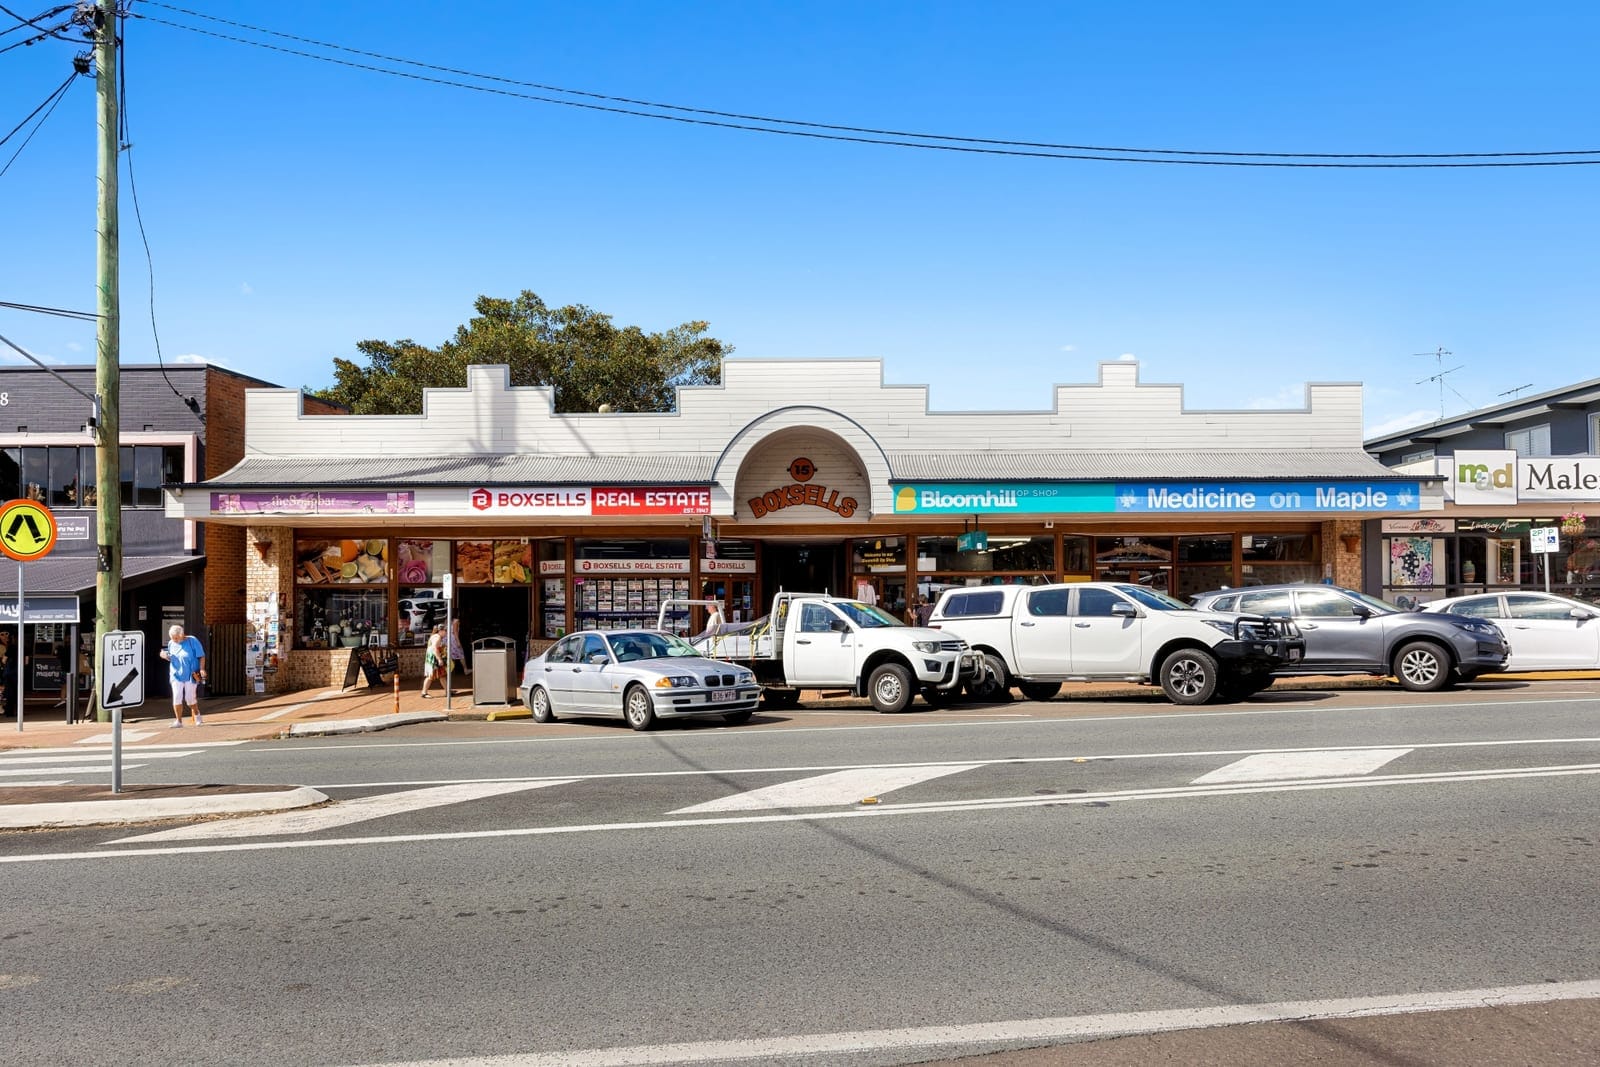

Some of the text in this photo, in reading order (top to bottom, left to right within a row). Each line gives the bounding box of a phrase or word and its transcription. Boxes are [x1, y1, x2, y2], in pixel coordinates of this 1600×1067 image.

[794, 465, 810, 475] 15
[1525, 462, 1600, 491] Male
[498, 493, 586, 507] BOXSELLS
[596, 492, 640, 507] REAL
[645, 491, 709, 506] ESTATE
[748, 484, 858, 519] BOXSELLS
[921, 490, 1018, 508] Bloomhill
[1032, 489, 1058, 497] SHOP
[1148, 487, 1388, 511] Medicine on Maple
[655, 562, 683, 570] ESTATE
[716, 562, 745, 570] BOXSELLS
[111, 639, 136, 651] KEEP
[112, 653, 135, 667] LEFT
